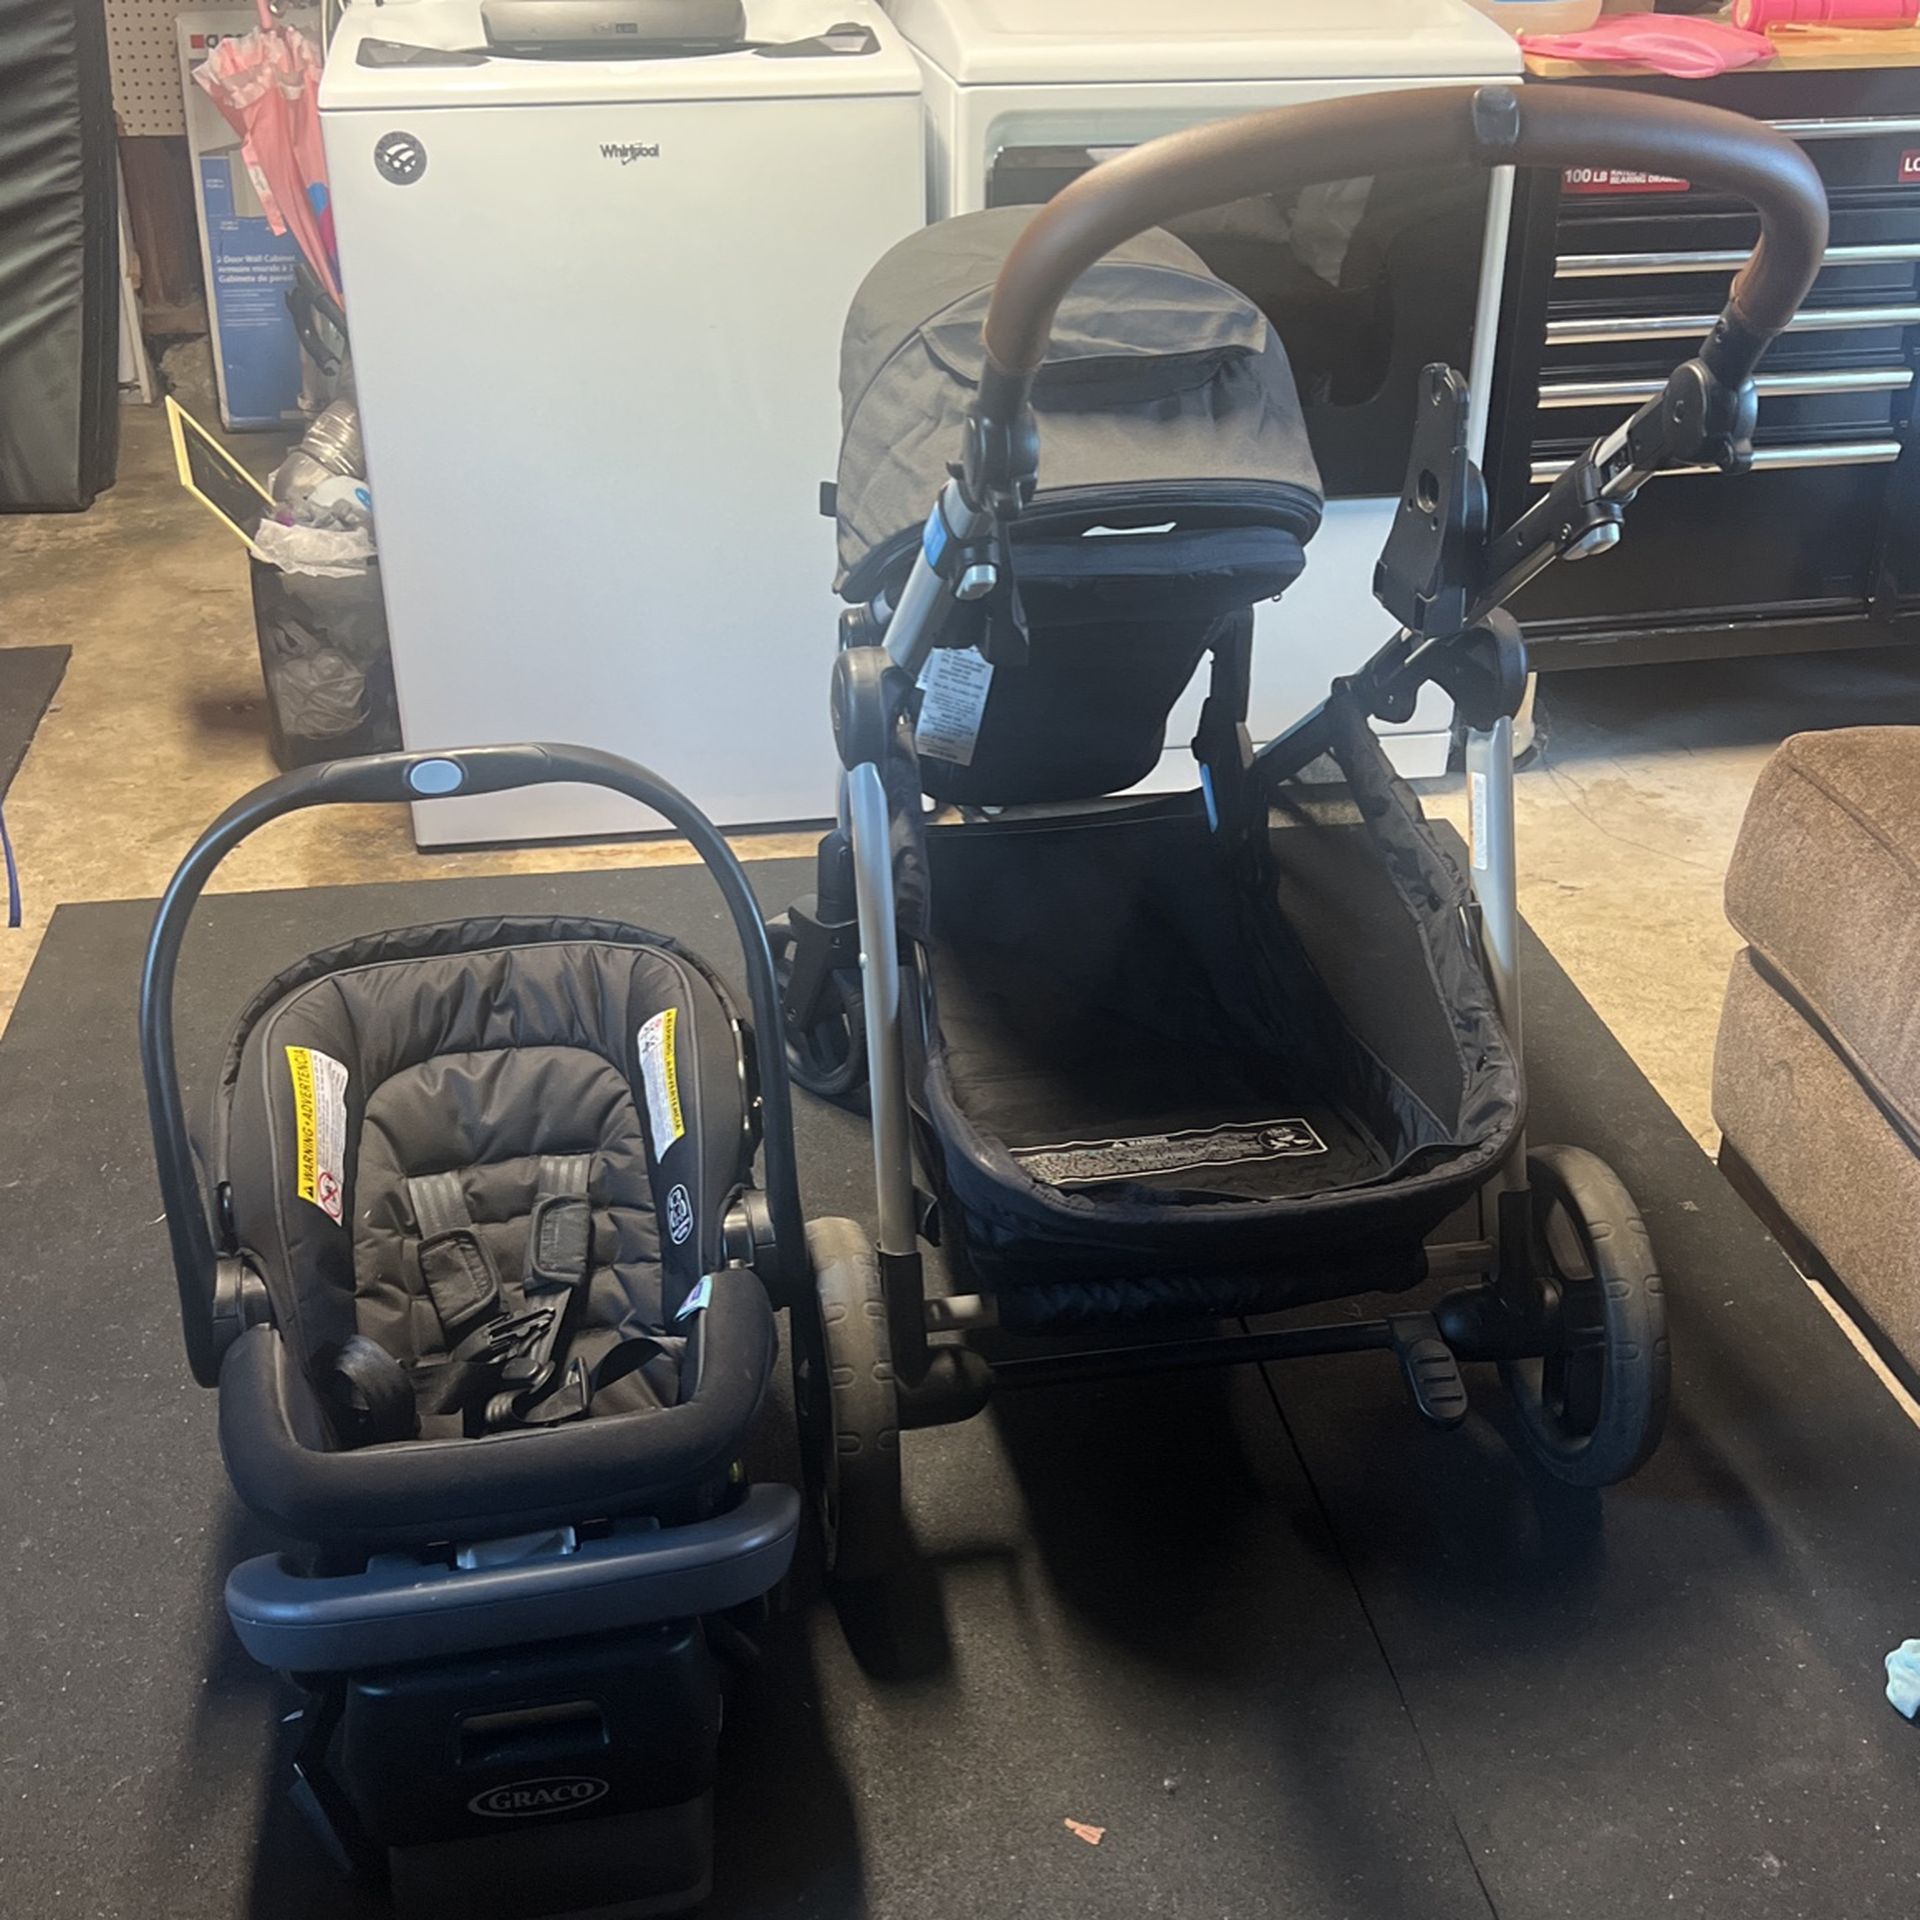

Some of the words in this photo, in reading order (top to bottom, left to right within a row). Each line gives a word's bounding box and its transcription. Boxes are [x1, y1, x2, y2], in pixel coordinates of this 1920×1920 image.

[600, 143, 660, 166] Whirlpool
[1564, 168, 1592, 184] 100
[1593, 171, 1608, 183] LB
[294, 1049, 313, 1123] ADVERTENCIA
[301, 1128, 314, 1183] WARNING
[488, 1782, 595, 1810] GRACO
